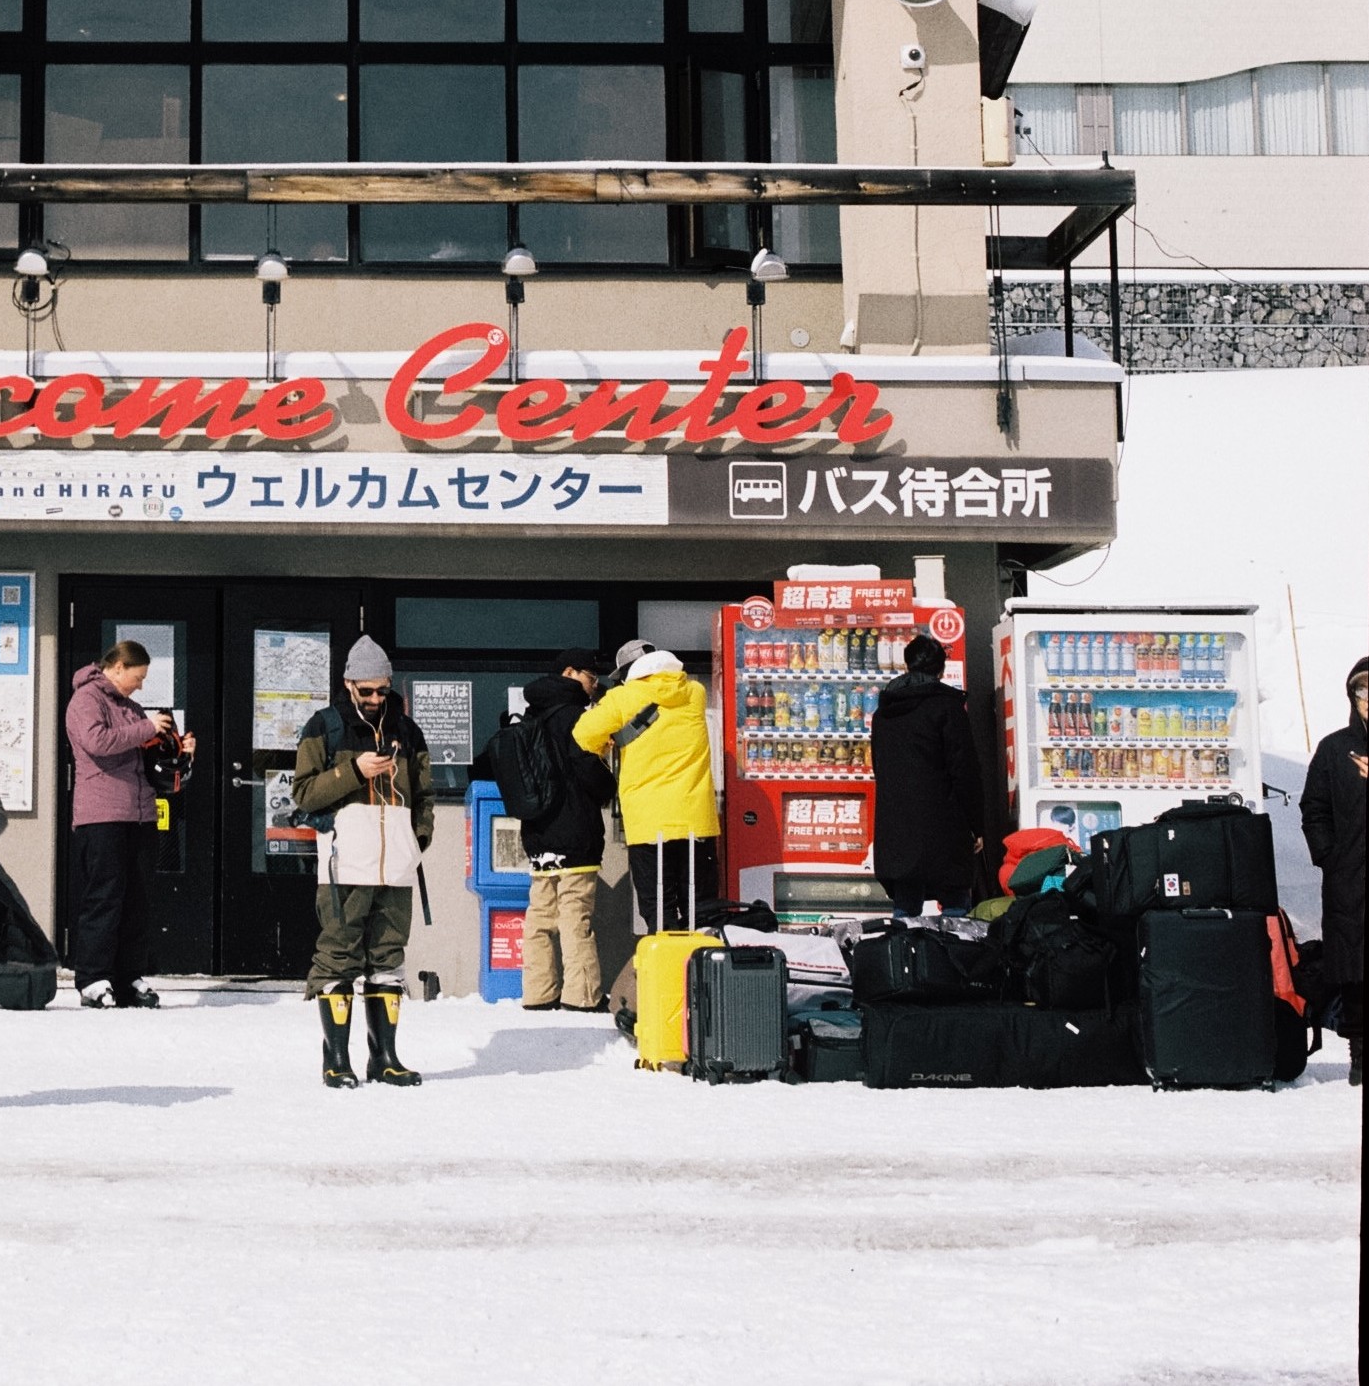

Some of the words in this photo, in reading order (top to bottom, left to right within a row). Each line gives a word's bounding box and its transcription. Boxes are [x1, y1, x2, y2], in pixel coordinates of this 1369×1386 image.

[384, 322, 893, 443] Center
[59, 484, 176, 498] HIRAFU
[196, 465, 643, 511] ウェルカムセンター
[798, 467, 1052, 517] バス待合所
[782, 586, 852, 609] 超高速
[855, 588, 881, 597] FREE
[415, 710, 449, 719] Smoking
[787, 799, 861, 824] 超高速
[787, 826, 813, 835] FREE
[909, 1073, 973, 1082] DAKINE
